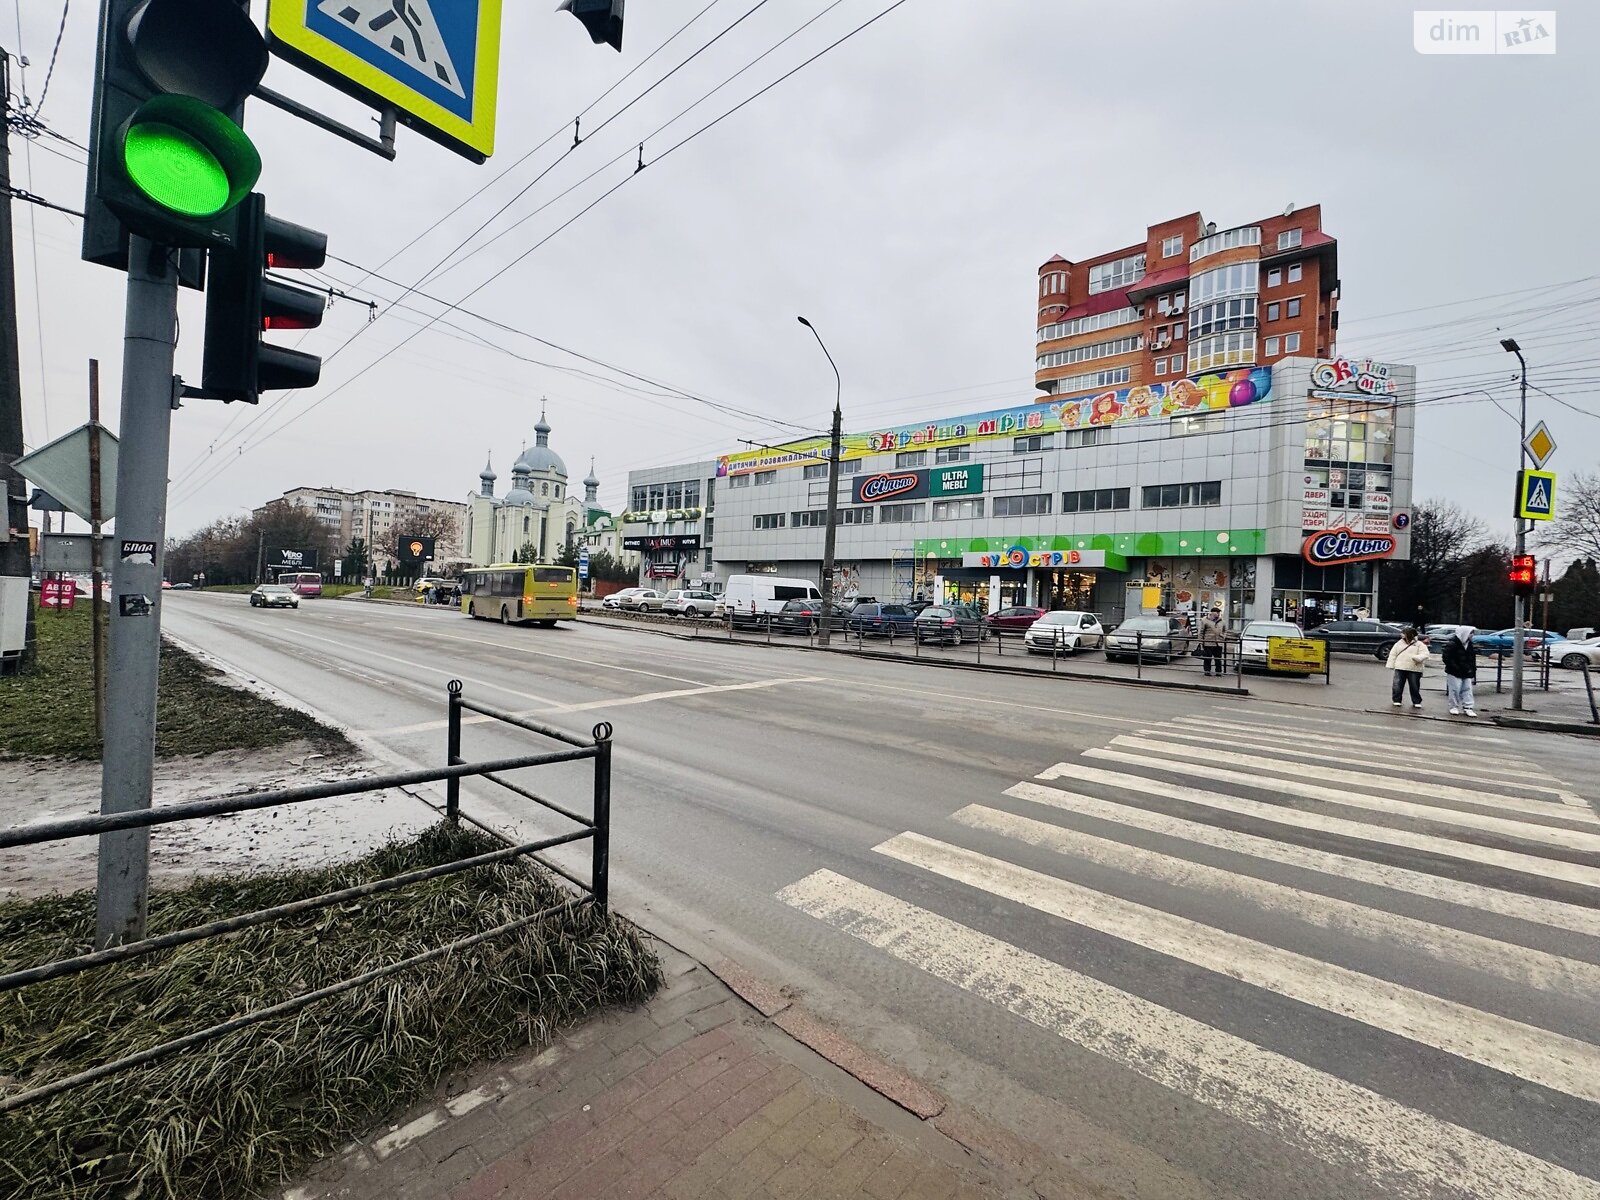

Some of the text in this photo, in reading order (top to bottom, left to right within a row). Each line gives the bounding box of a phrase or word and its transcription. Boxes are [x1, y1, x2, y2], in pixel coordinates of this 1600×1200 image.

[728, 446, 847, 471] ДИТЯЧИЙ РОЗВАЖАЛЬНИЙ ЦЕР
[942, 470, 969, 481] ULTRA
[865, 476, 914, 497] Сільпо
[942, 480, 968, 491] MEBLI
[1304, 491, 1326, 499] ДВЕРІ
[1303, 519, 1325, 527] ДВЕРІ
[123, 542, 154, 552] БПЛА
[1314, 532, 1392, 559] Сільпо
